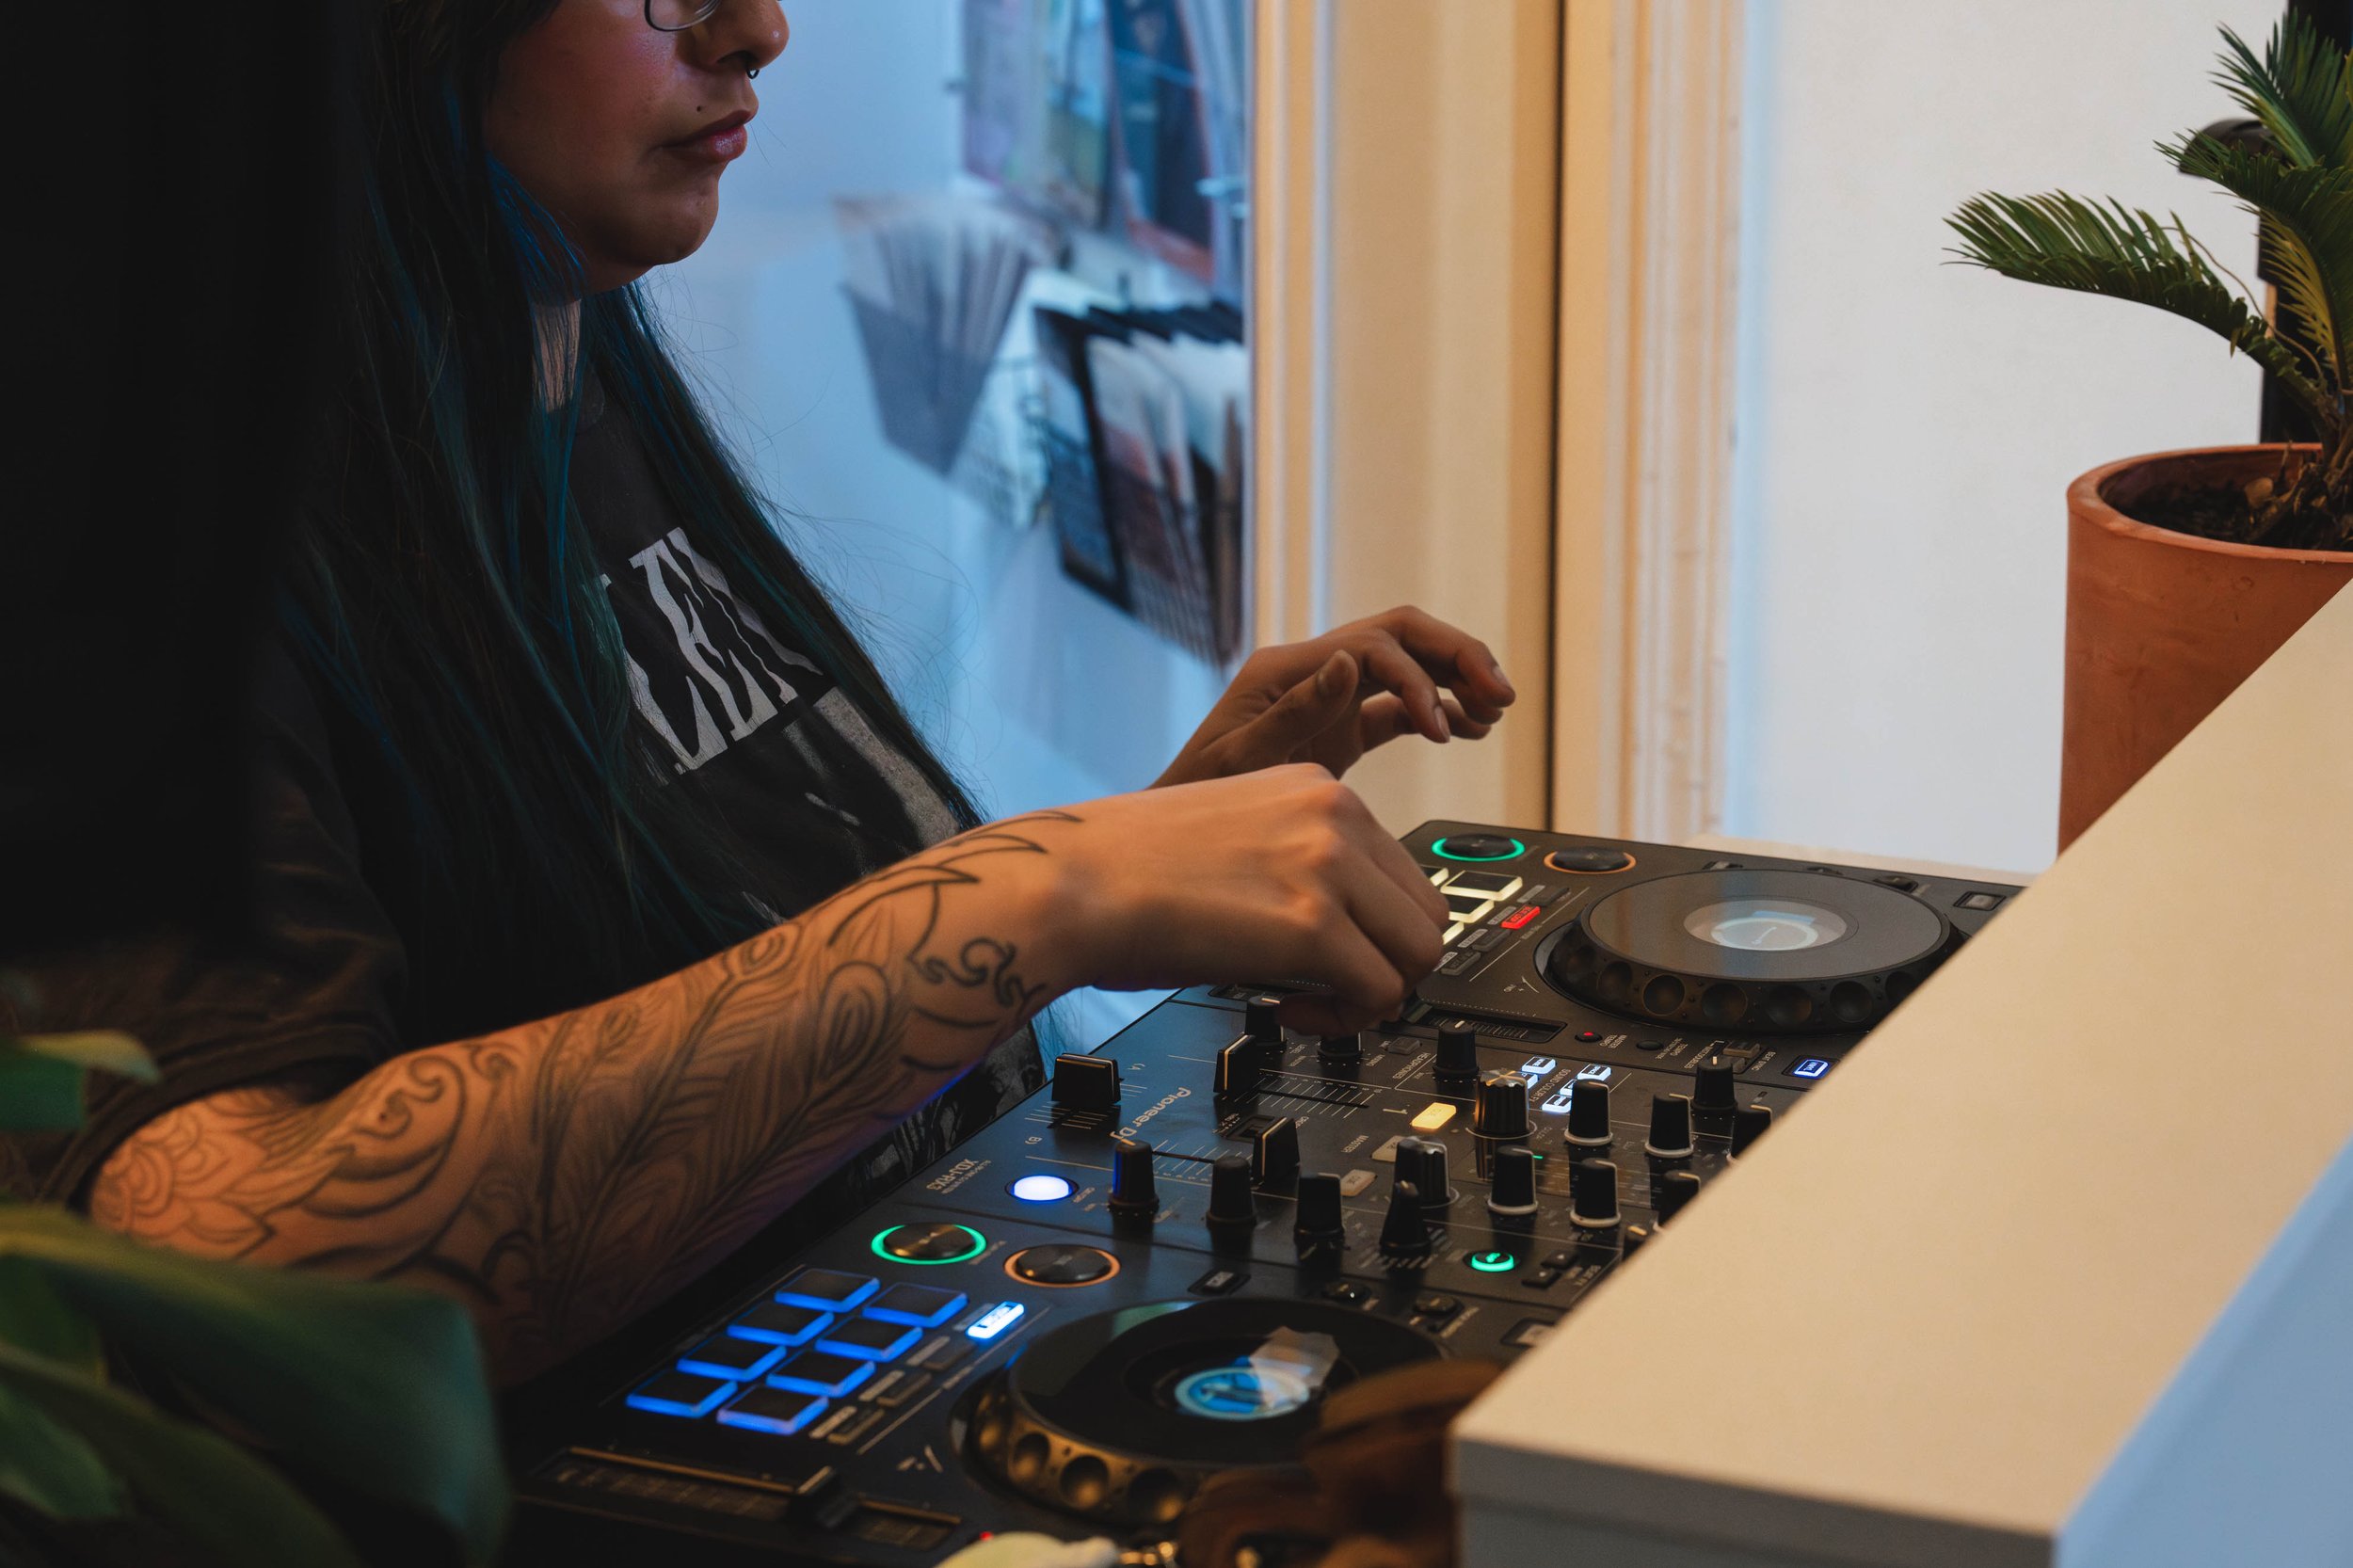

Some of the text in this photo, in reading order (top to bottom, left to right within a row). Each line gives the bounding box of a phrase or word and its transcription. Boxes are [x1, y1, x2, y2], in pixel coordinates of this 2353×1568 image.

[1549, 1068, 1572, 1083] SOUND
[1536, 1082, 1556, 1096] COLOR
[1132, 1087, 1192, 1128] Pioneer
[1340, 1135, 1369, 1154] MASTER
[925, 1159, 978, 1191] XDJ-RX3
